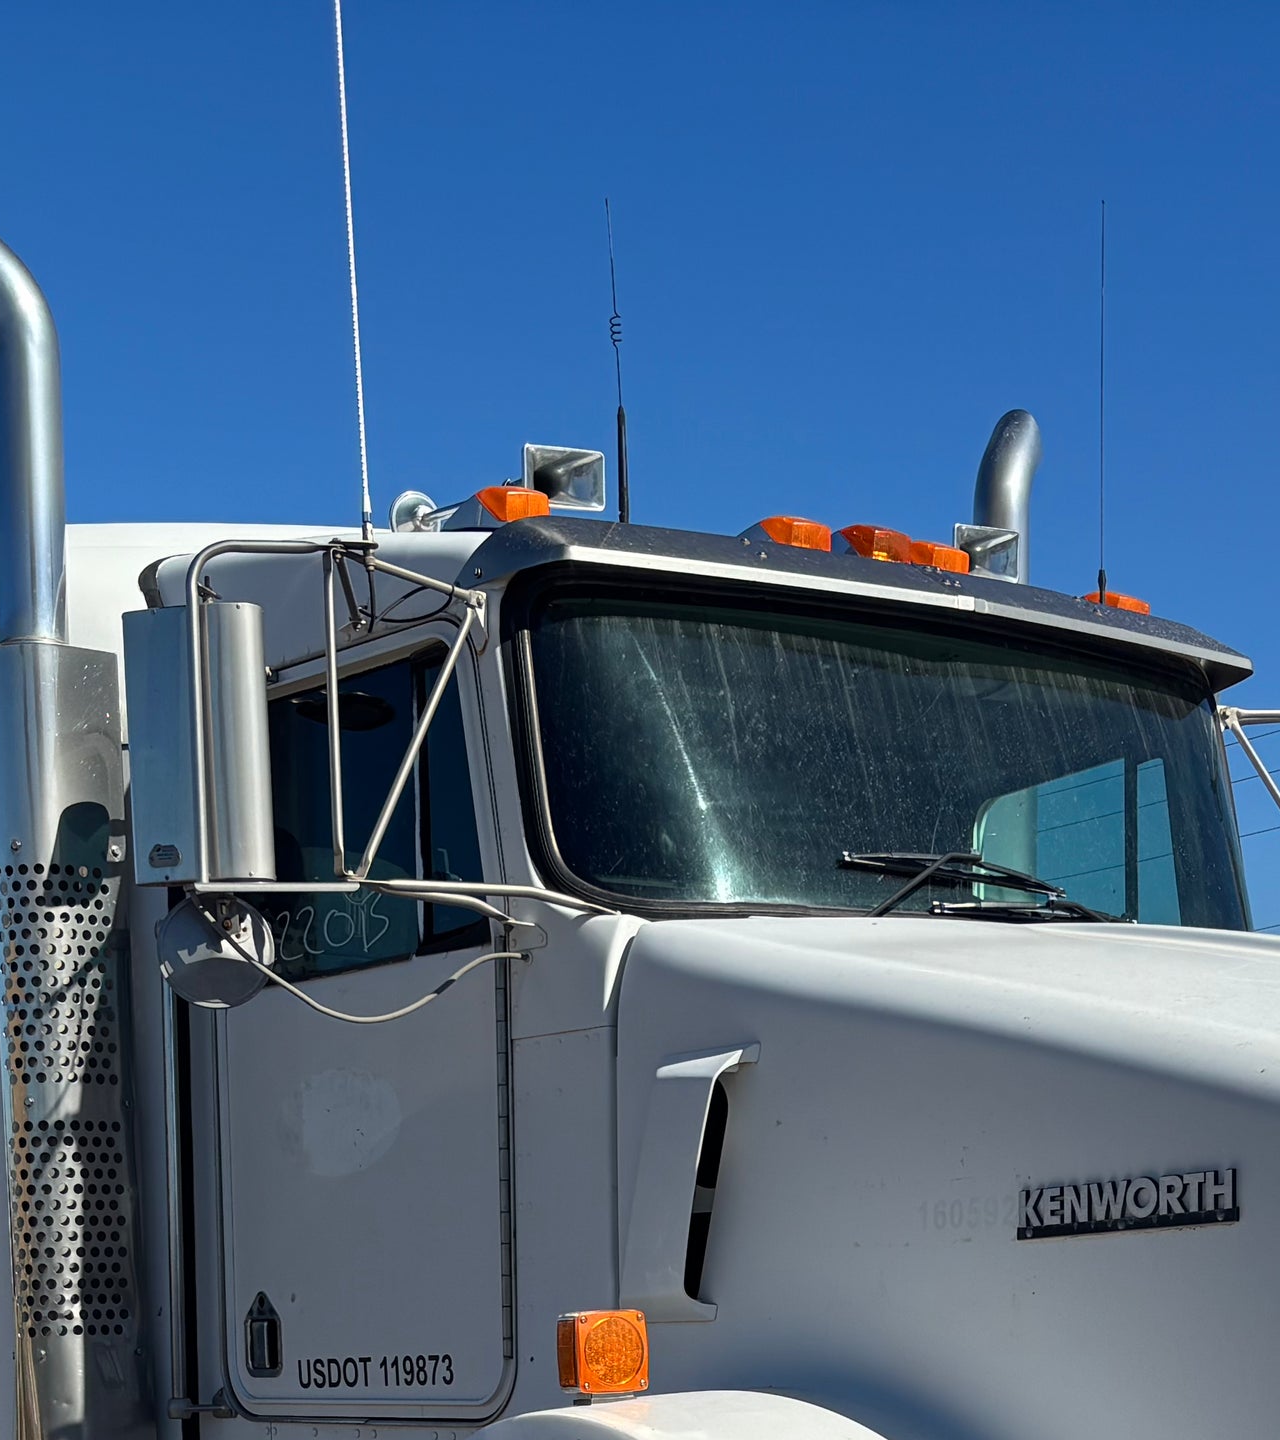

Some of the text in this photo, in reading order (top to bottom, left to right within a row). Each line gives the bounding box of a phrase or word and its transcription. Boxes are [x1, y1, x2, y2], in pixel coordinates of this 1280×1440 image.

[1019, 1168, 1238, 1230] KENWORTH
[297, 1354, 454, 1389] USDOT 119873
